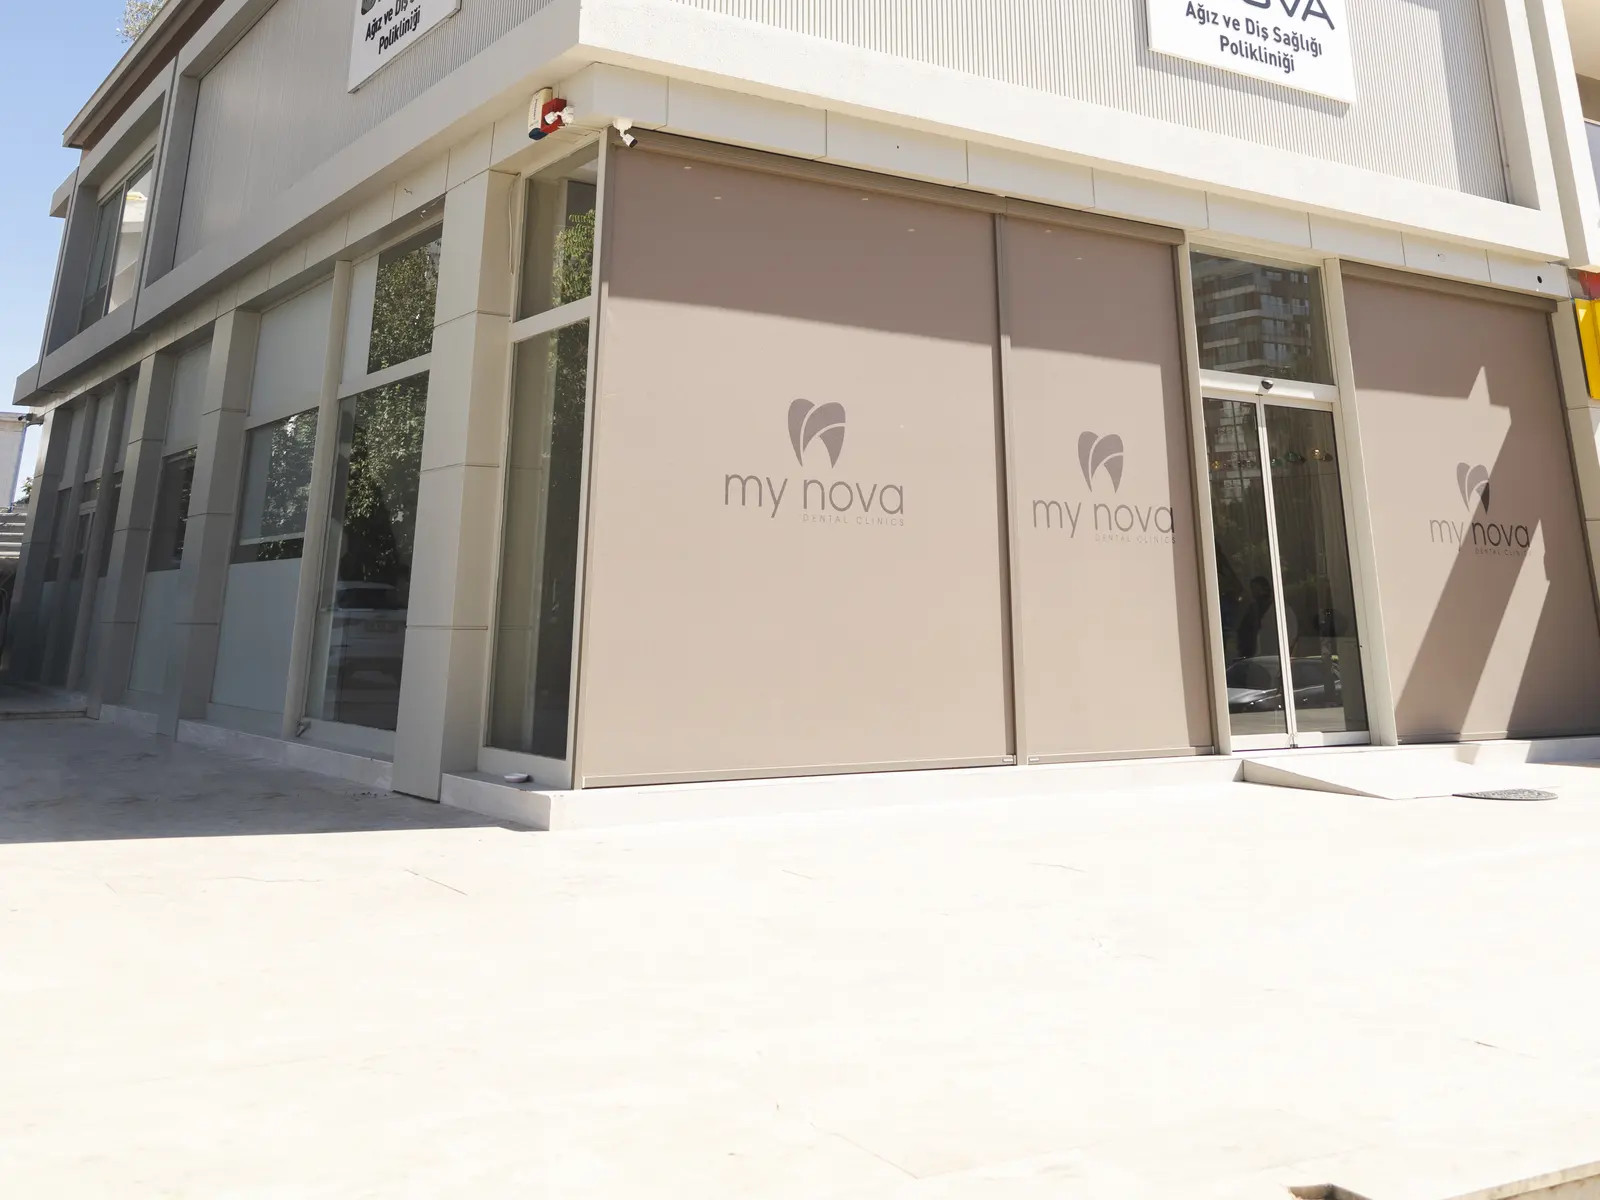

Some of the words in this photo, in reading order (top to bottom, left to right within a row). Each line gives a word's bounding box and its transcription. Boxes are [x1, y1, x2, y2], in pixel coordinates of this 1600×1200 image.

[379, 5, 421, 54] Polikliniği
[383, 11, 393, 26] ve
[1185, 1, 1219, 25] Ağız
[1223, 15, 1240, 31] ve
[1245, 18, 1269, 40] Diş
[1273, 26, 1322, 58] Sağlığı
[1220, 35, 1295, 74] Polikliniği
[725, 474, 788, 518] my
[803, 479, 903, 515] nova
[803, 514, 848, 524] DENTAL
[856, 516, 905, 526] CLINICS
[1033, 500, 1081, 538] my
[1094, 503, 1175, 533] nova
[1429, 519, 1463, 552] my
[1472, 522, 1530, 548] nova
